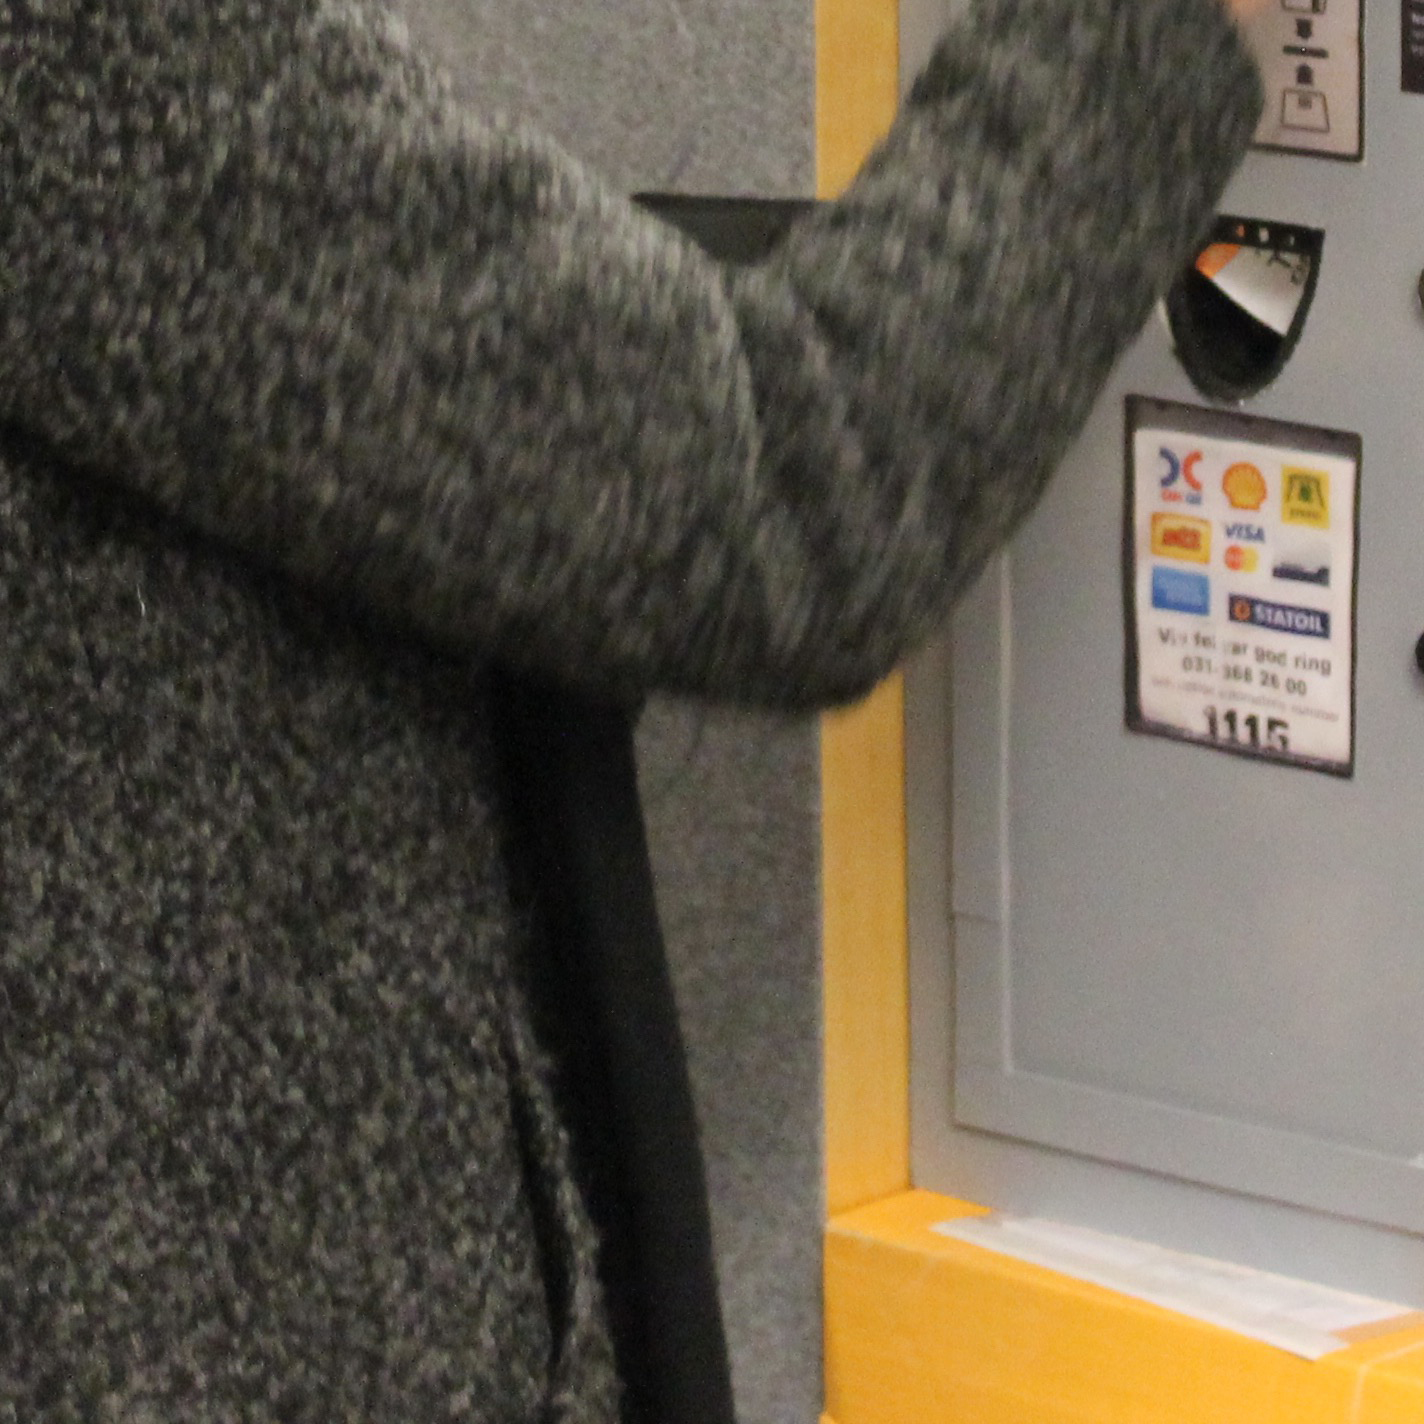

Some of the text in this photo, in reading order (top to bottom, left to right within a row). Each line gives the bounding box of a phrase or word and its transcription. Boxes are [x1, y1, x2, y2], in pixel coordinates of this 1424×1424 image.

[1226, 523, 1265, 543] VISA
[1254, 602, 1323, 632] STATOIL
[1294, 652, 1331, 676] ring
